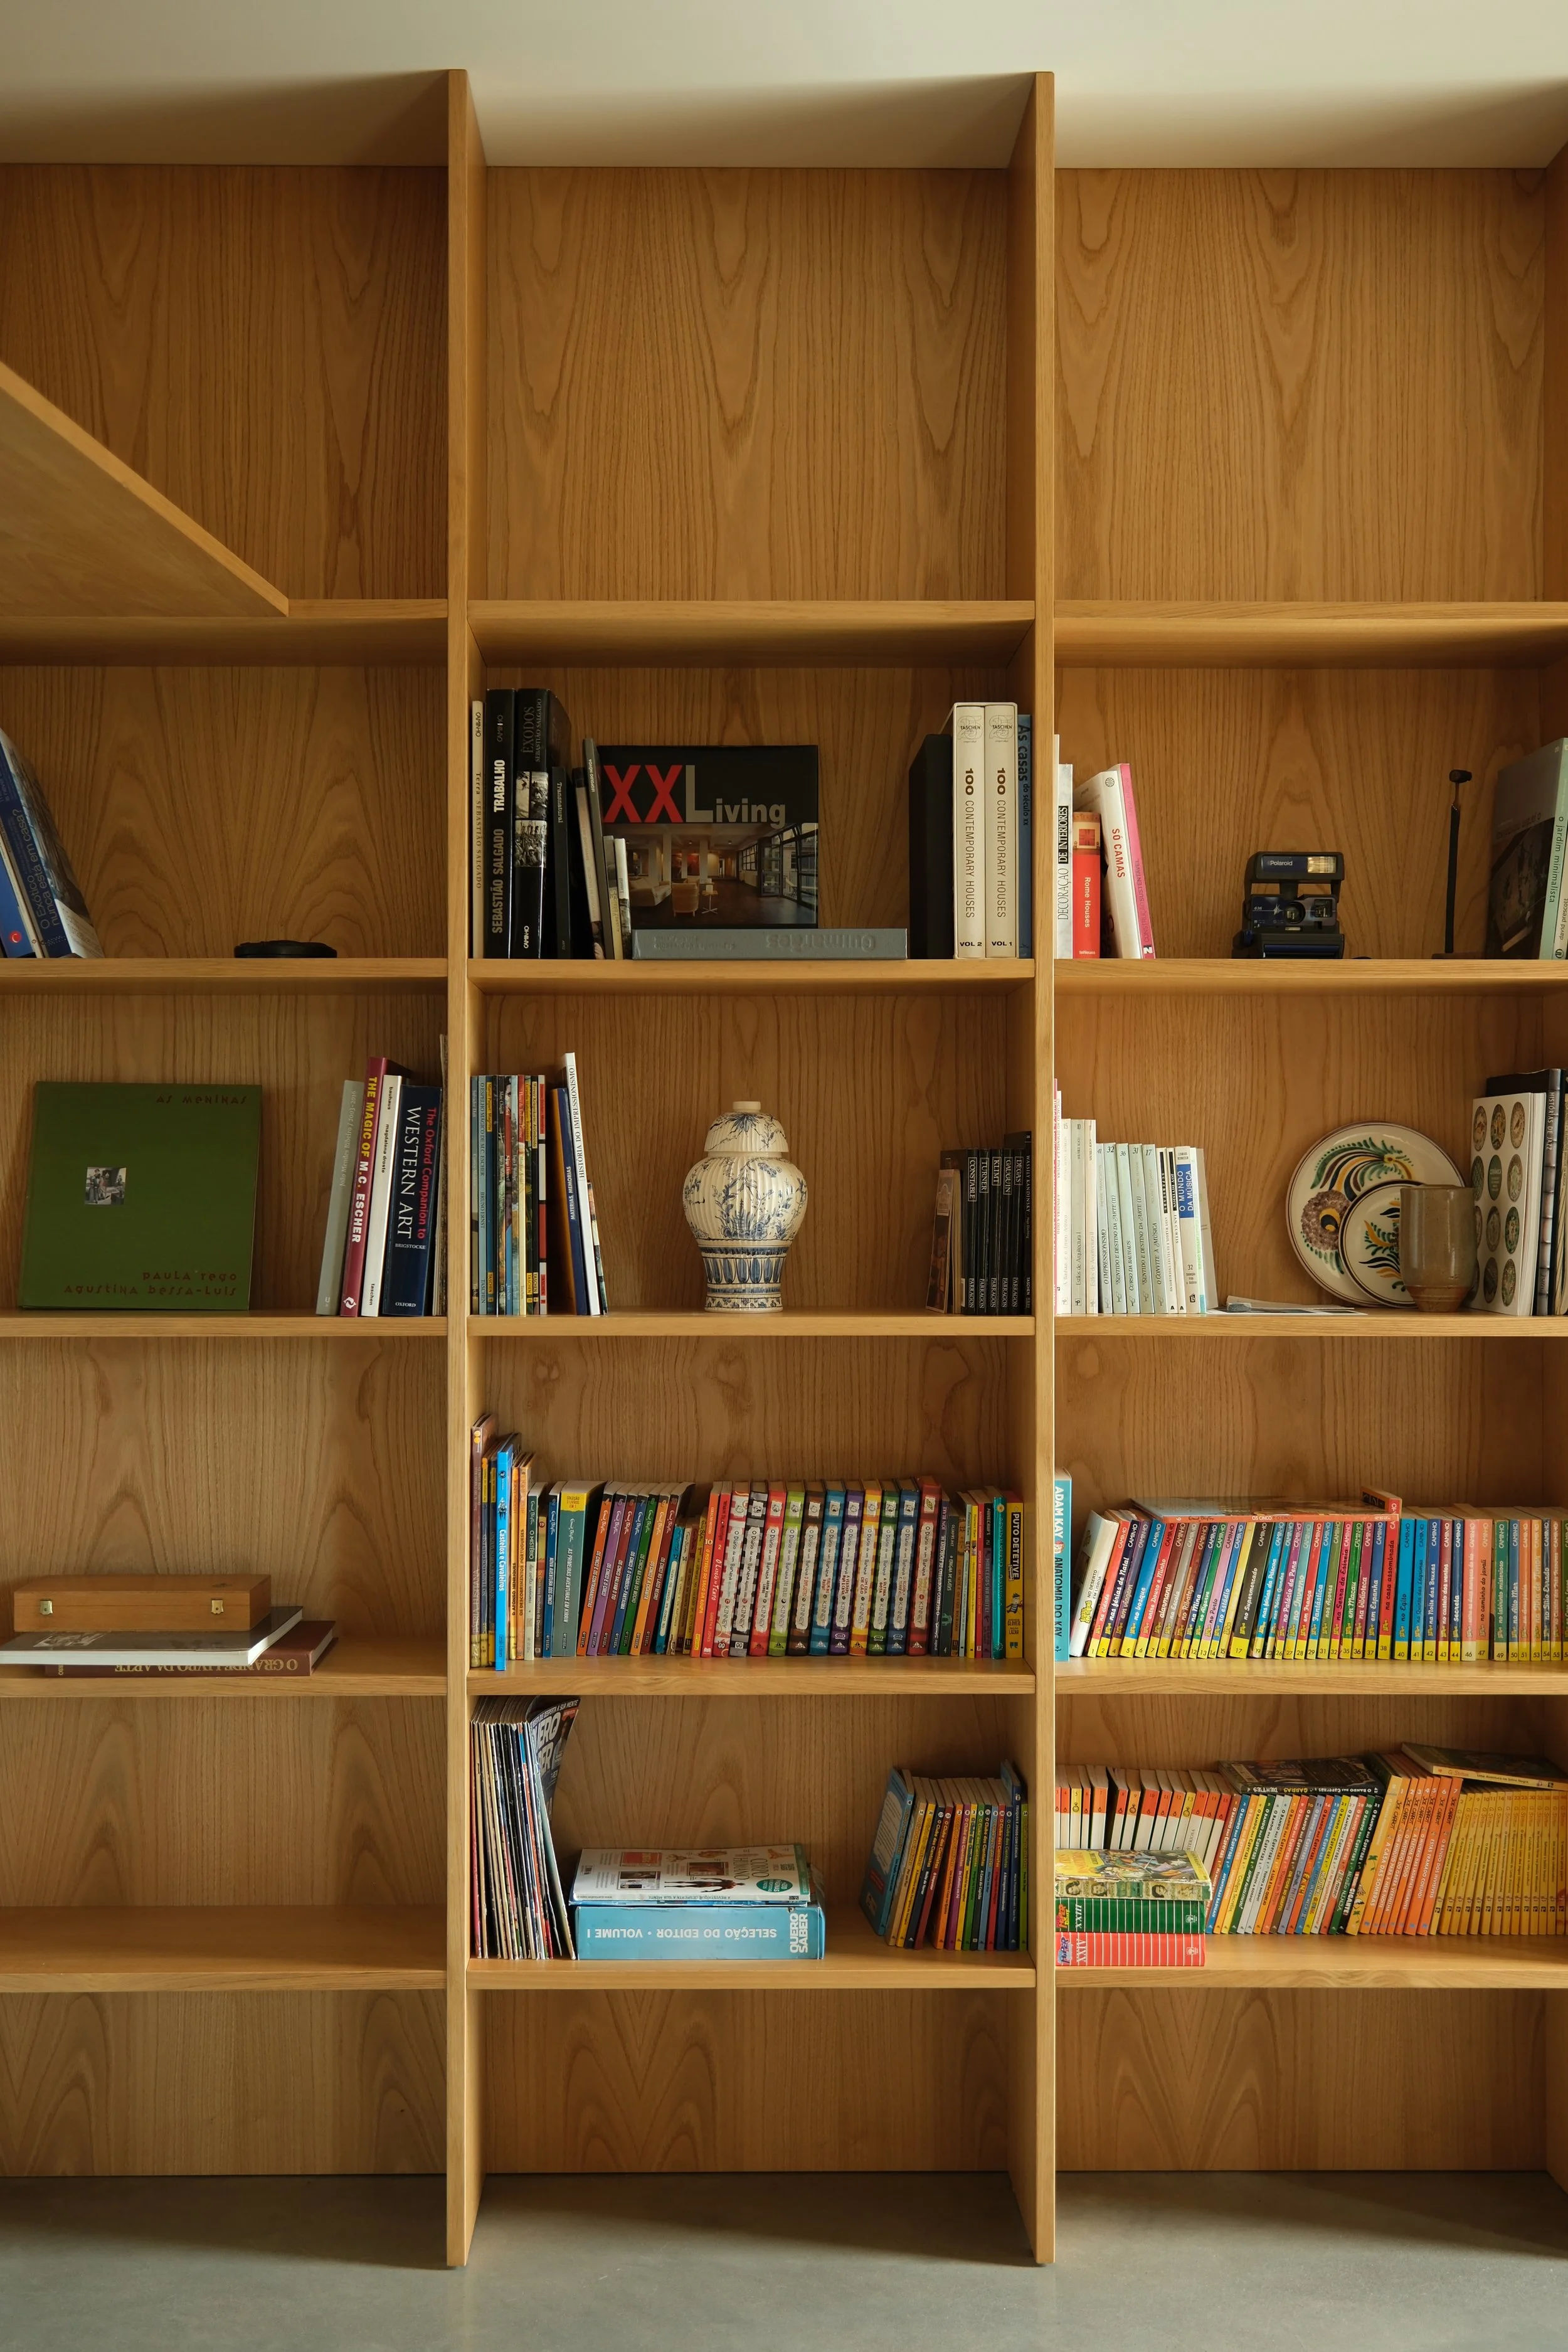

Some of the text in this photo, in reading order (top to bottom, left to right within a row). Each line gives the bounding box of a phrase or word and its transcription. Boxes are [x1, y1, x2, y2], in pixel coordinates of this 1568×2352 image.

[521, 706, 534, 753] ÊXODOS
[1017, 724, 1030, 741] As
[1017, 746, 1028, 781] casas
[494, 759, 506, 813] TRABALHO
[1023, 783, 1030, 793] do
[1022, 794, 1030, 817] século
[965, 768, 975, 918] 100 CONTEMPORARY HOUSES
[997, 767, 1006, 918] 100 CONTEMPORARY HOUSES
[1058, 806, 1067, 851] INTERIORES
[1554, 824, 1565, 853] jardim
[12, 808, 60, 926] nunca está em casa?
[1058, 852, 1067, 863] DE
[1112, 828, 1125, 878] SÓ CAMAS
[490, 829, 504, 934] SEBASTIÃO SALGADO
[1549, 855, 1562, 903] minimalista
[27, 875, 50, 930] O Exótico
[156, 1094, 173, 1104] AS
[569, 1067, 585, 1178] HISTÓRIA DO IMPRESSIONISMO
[351, 1076, 378, 1243] THE MAGIC OF M.C. ESCHER
[397, 1106, 421, 1239] WESTERN ART
[416, 1107, 437, 1239] The Oxford Companion to
[1187, 1202, 1194, 1211] DA
[1054, 1486, 1064, 1539] ADAM KAY
[1128, 1523, 1138, 1547] CAMINHO
[1152, 1523, 1162, 1547] CAMINHO
[1054, 1557, 1063, 1601] ANATOMIA
[1108, 1608, 1116, 1621] nas
[1112, 1587, 1122, 1607] férias
[1119, 1557, 1130, 1576] Natal
[1244, 1567, 1258, 1611] Supermercado
[1054, 1604, 1062, 1618] DO
[1133, 1587, 1147, 1621] no bosque
[1385, 1602, 1390, 1611] na
[1429, 1616, 1434, 1624] na
[1389, 1811, 1399, 1830] CARROT
[1227, 1838, 1237, 1860] Cavernas
[1211, 1873, 1227, 1917] AVENTURAS RADICAIS
[1370, 1878, 1381, 1907] SOMBRAS
[595, 1929, 643, 1938] VOLUME
[657, 1929, 698, 1938] EDITOR
[704, 1929, 719, 1937] DO
[723, 1926, 777, 1940] SELEÇÃO
[790, 1913, 798, 1952] QUERO
[799, 1913, 808, 1952] SABER
